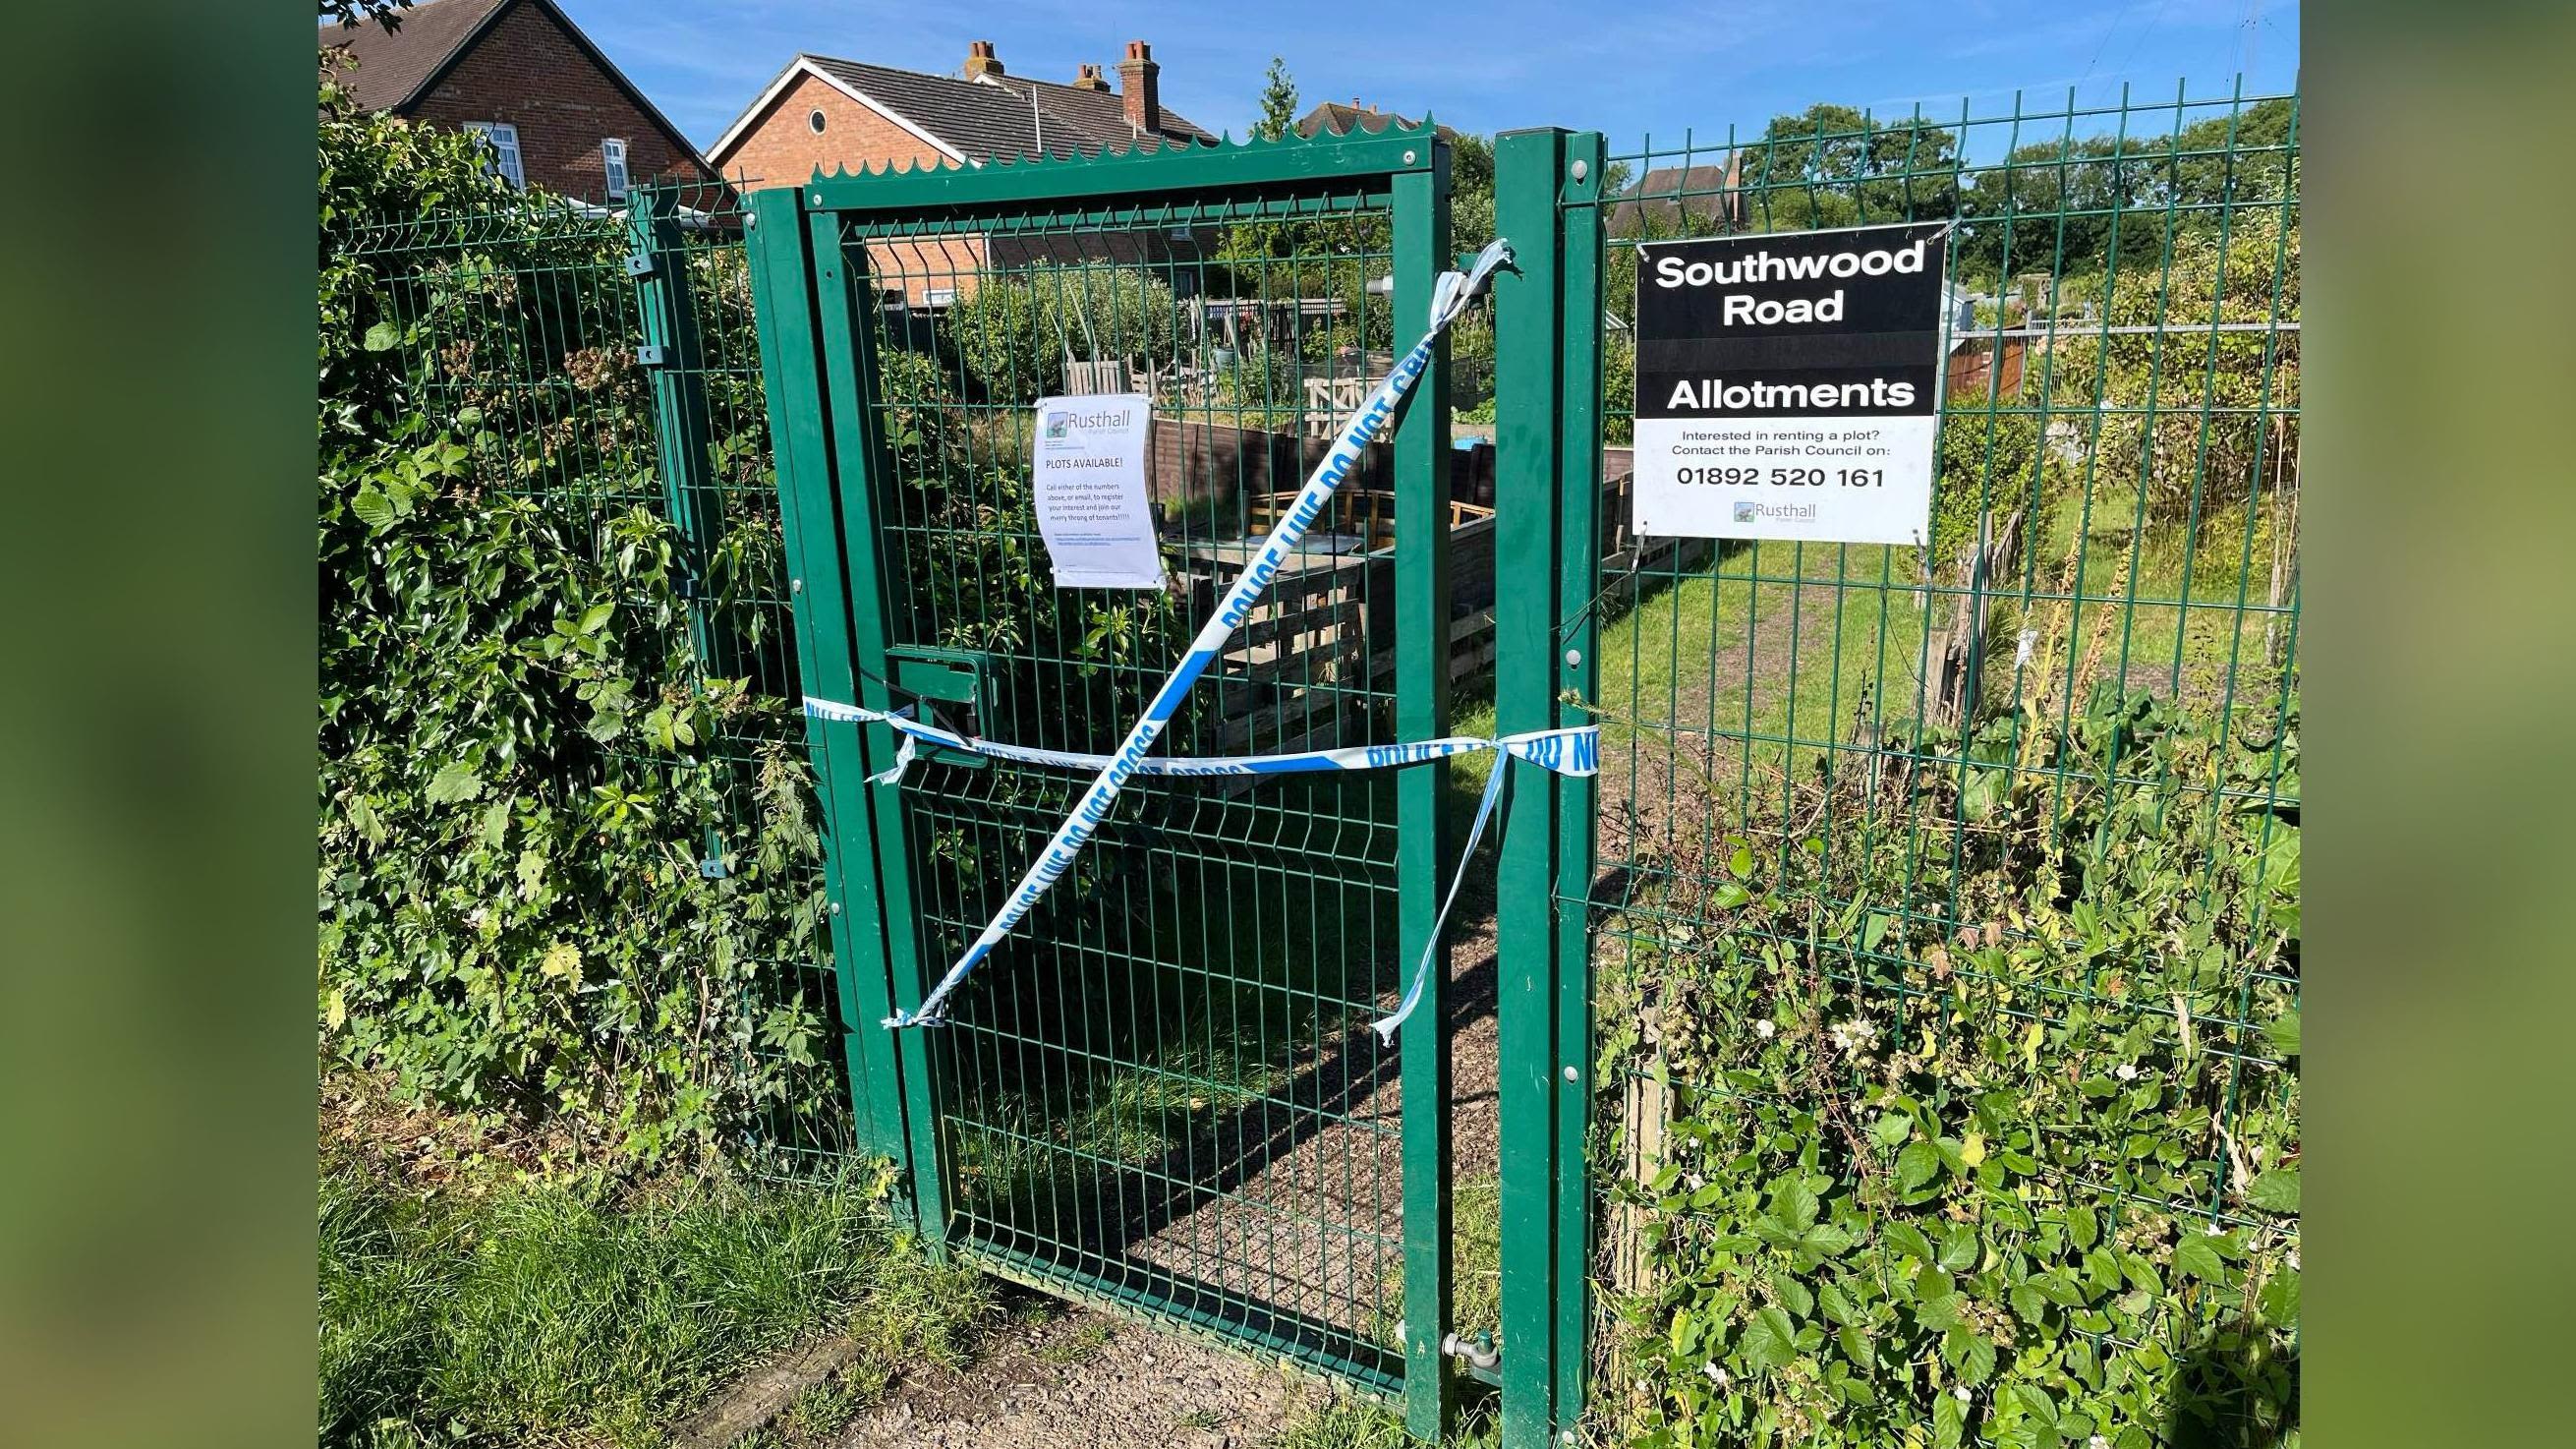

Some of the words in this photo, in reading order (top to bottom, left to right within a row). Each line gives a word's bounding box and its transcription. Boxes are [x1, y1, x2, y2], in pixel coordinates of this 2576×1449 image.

[1655, 240, 1925, 288] Southwood
[1724, 290, 1844, 326] Road
[1667, 377, 1916, 409] Allotments
[1068, 410, 1130, 429] Rusthall
[1682, 431, 1751, 440] Interested
[1756, 431, 1768, 440] in
[1773, 431, 1824, 443] renting
[1843, 431, 1880, 443] plot?
[1672, 445, 1725, 455] Contact
[1729, 445, 1750, 455] the
[1755, 445, 1801, 455] Parish
[1805, 445, 1861, 455] Council
[1866, 447, 1891, 456] on:
[1046, 458, 1071, 469] PLOTS
[1073, 457, 1123, 468] AVAILABLE!
[1677, 467, 1759, 486] 01892
[1770, 468, 1826, 487] 520
[1837, 468, 1883, 488] 161
[1094, 482, 1119, 491] numbers
[1755, 503, 1816, 517] Rusthall
